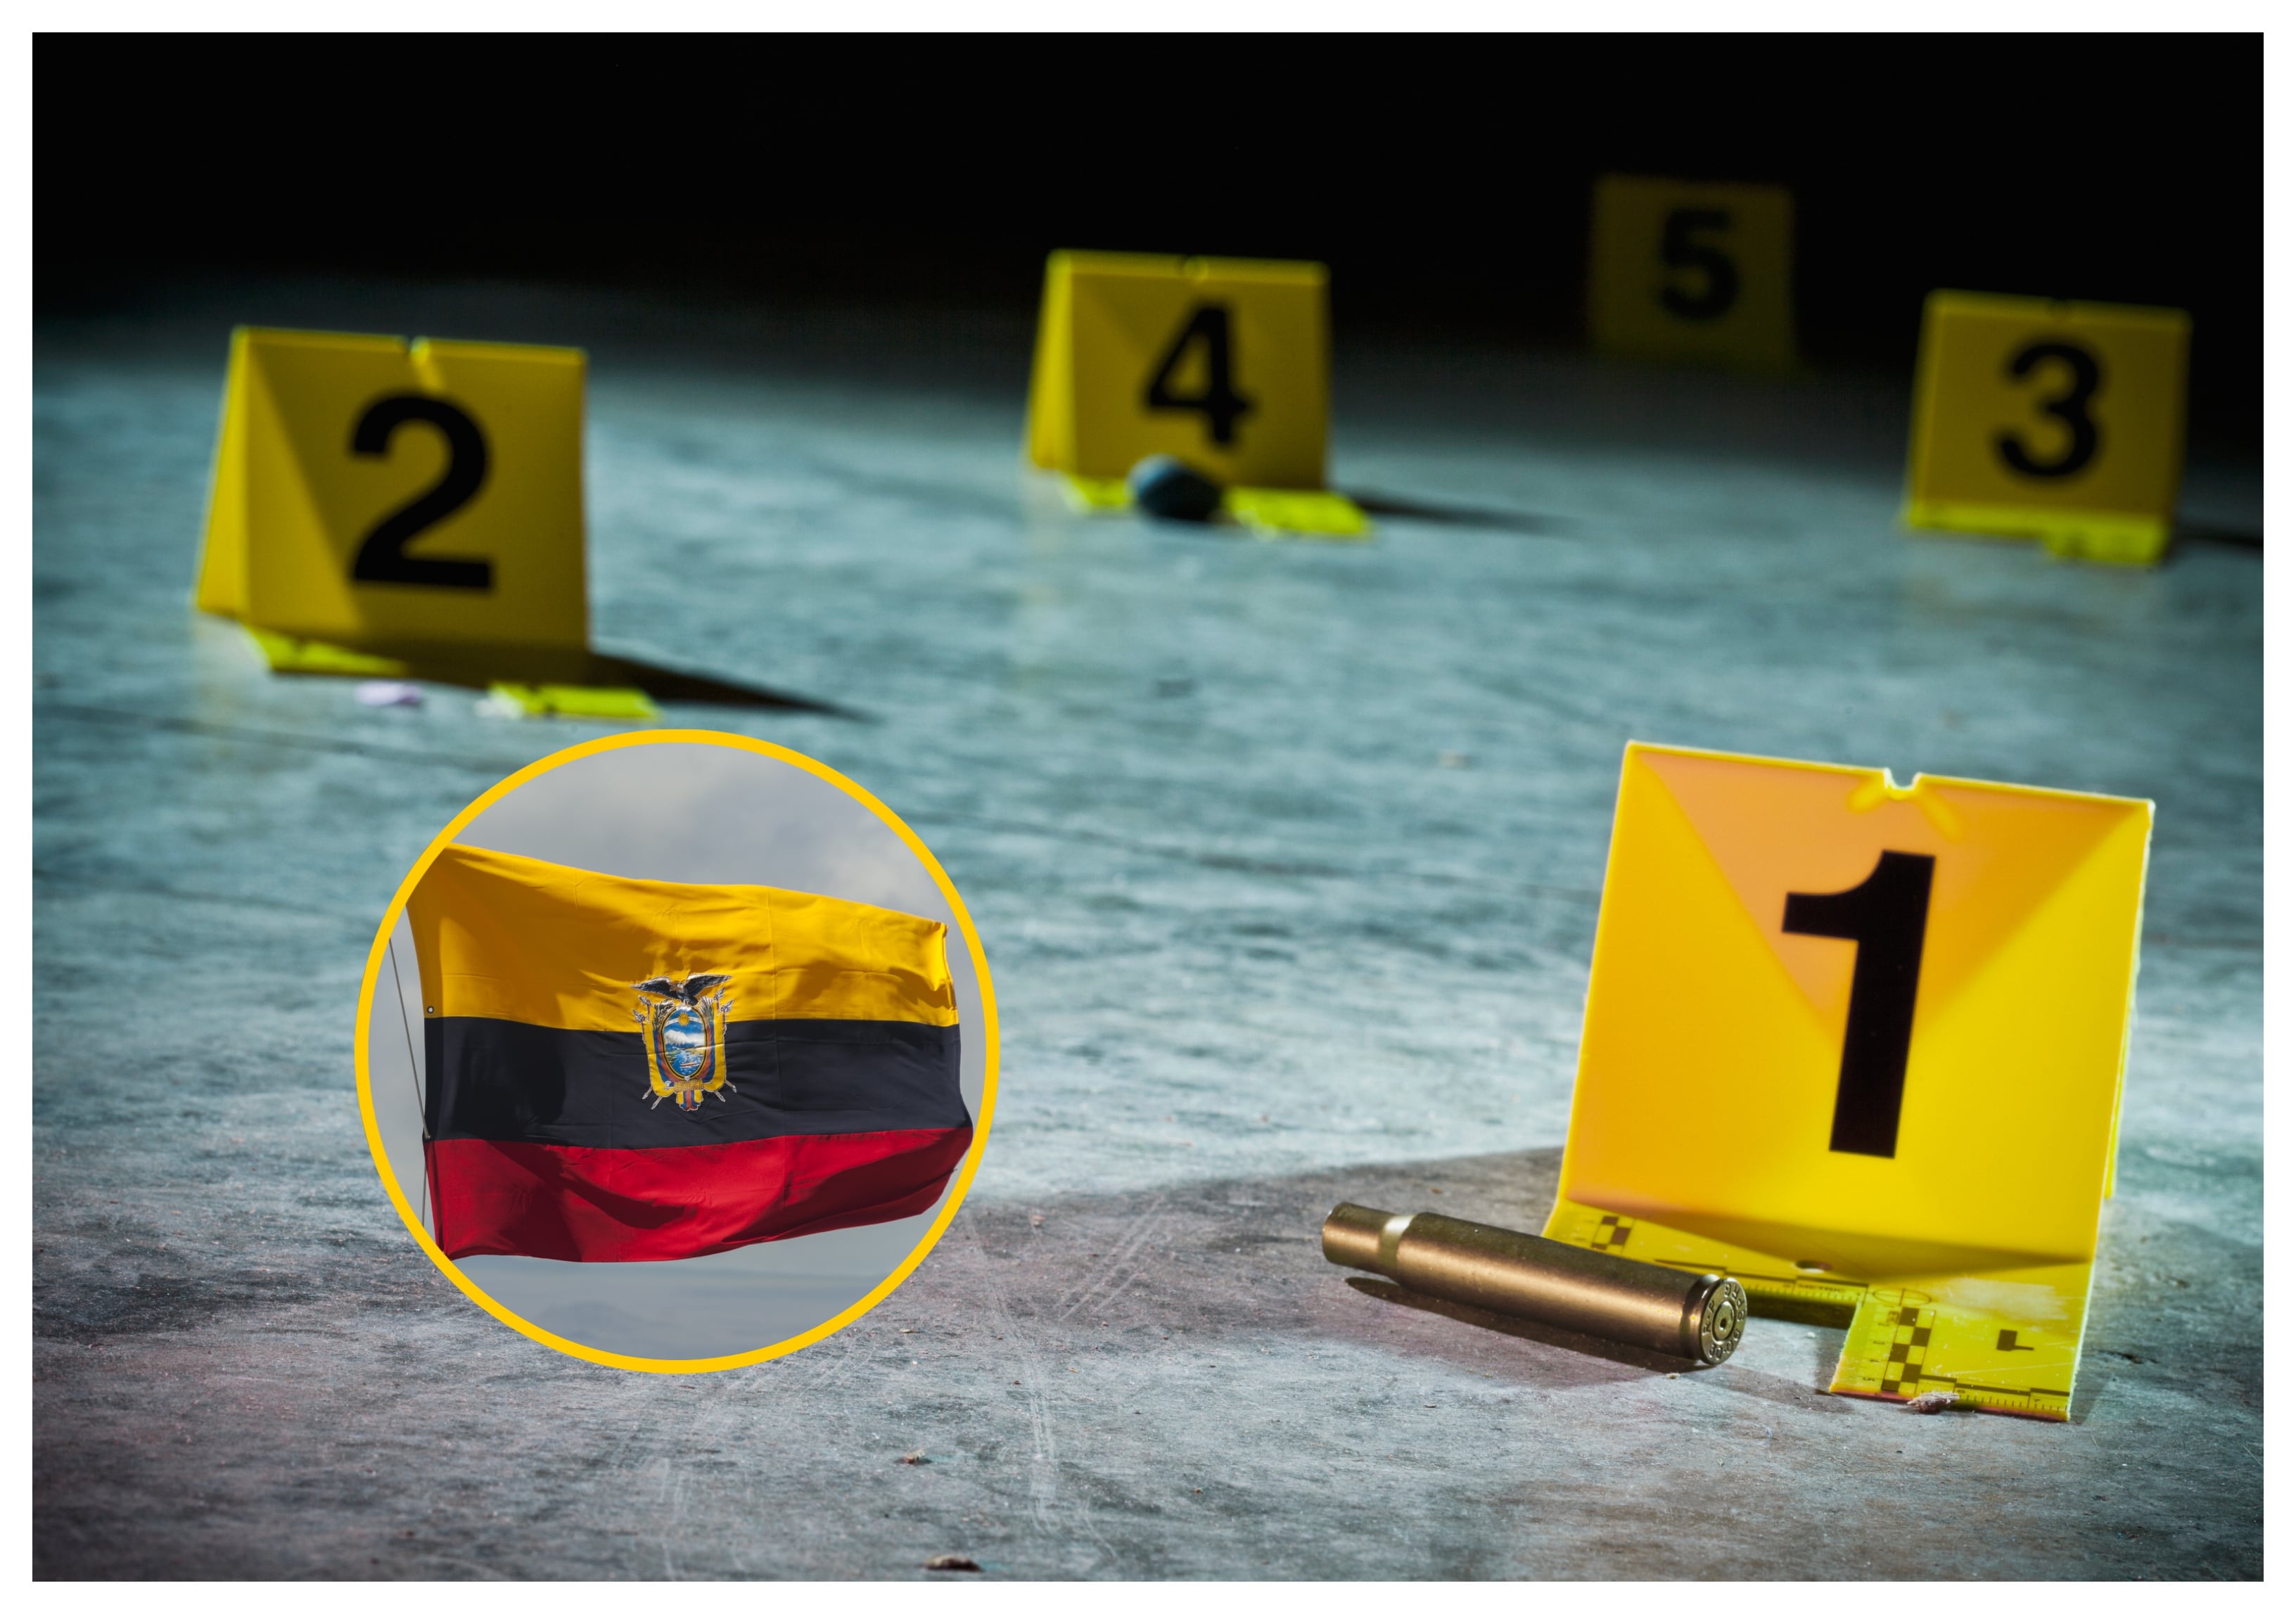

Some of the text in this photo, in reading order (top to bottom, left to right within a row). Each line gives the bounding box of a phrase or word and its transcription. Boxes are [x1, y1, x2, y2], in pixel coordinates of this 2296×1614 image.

[1657, 206, 1742, 324] 5
[1144, 301, 1257, 449] 4
[1995, 335, 2107, 484] 3
[348, 391, 496, 595] 2
[1782, 851, 1935, 1158] 1
